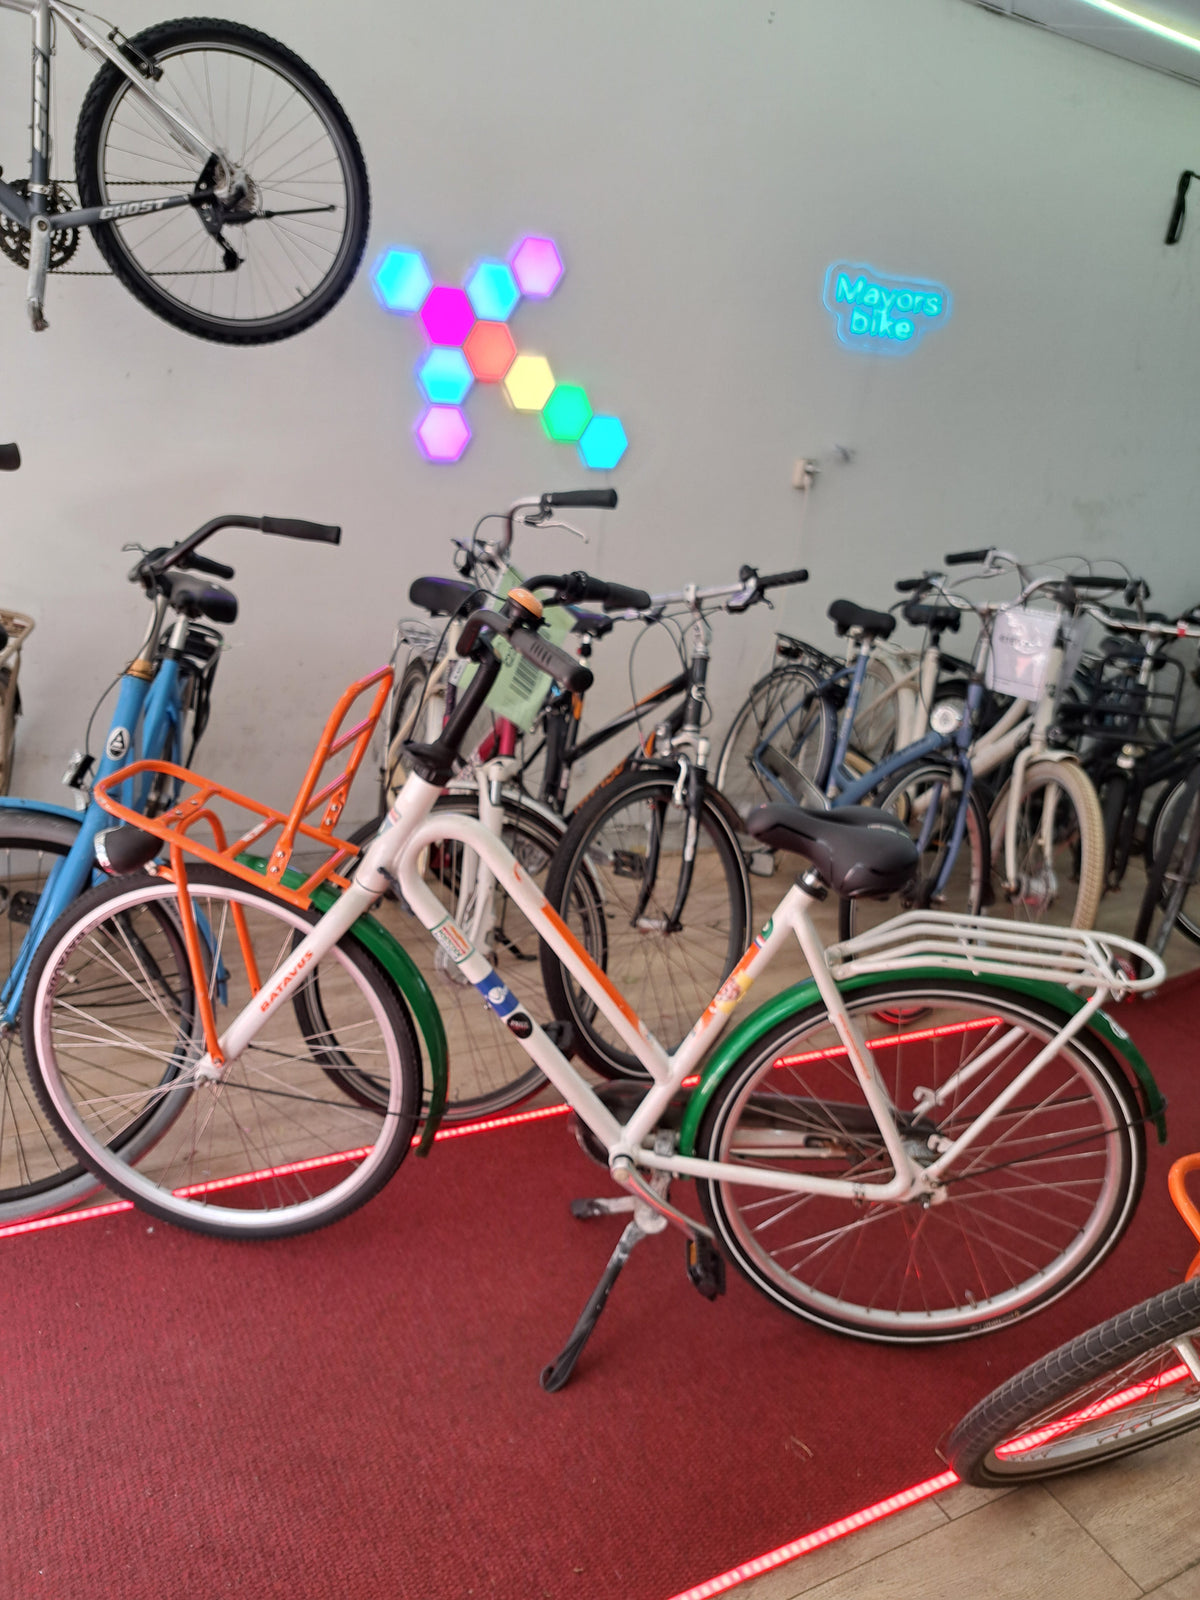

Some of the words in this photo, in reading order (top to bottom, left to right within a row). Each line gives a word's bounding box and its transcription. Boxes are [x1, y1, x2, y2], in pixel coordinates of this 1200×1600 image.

[99, 199, 169, 220] GHOST
[837, 273, 942, 316] Mayors
[851, 307, 914, 340] bike
[261, 950, 313, 1012] BATAVUS
